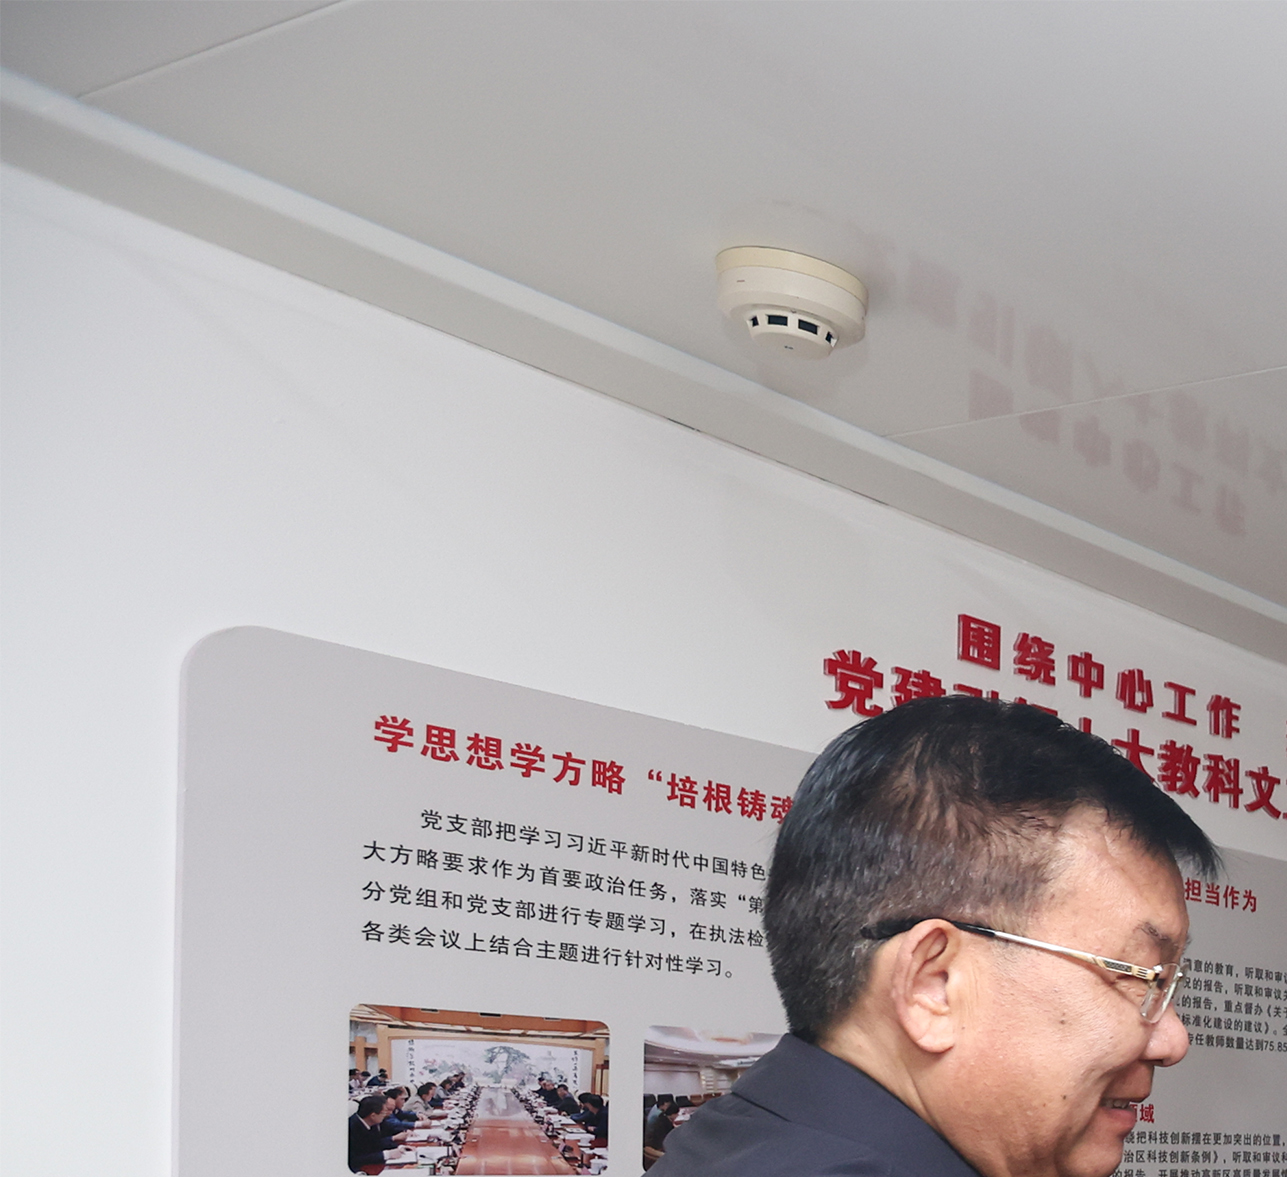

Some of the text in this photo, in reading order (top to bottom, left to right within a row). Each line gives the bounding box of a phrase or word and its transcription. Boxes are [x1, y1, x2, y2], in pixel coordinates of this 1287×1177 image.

[957, 614, 1241, 738] 围绕中心工作
[362, 841, 763, 914] 大方略要求作为首要政治任务，落实“第
[420, 809, 766, 881] 党支部把学习习近平新时代中国特色
[362, 881, 764, 947] 分党组和党支部进行专题学习，在执法检
[1184, 877, 1257, 913] 担当作为
[361, 921, 732, 978] 各类会议上结合主题进行针对性学习。
